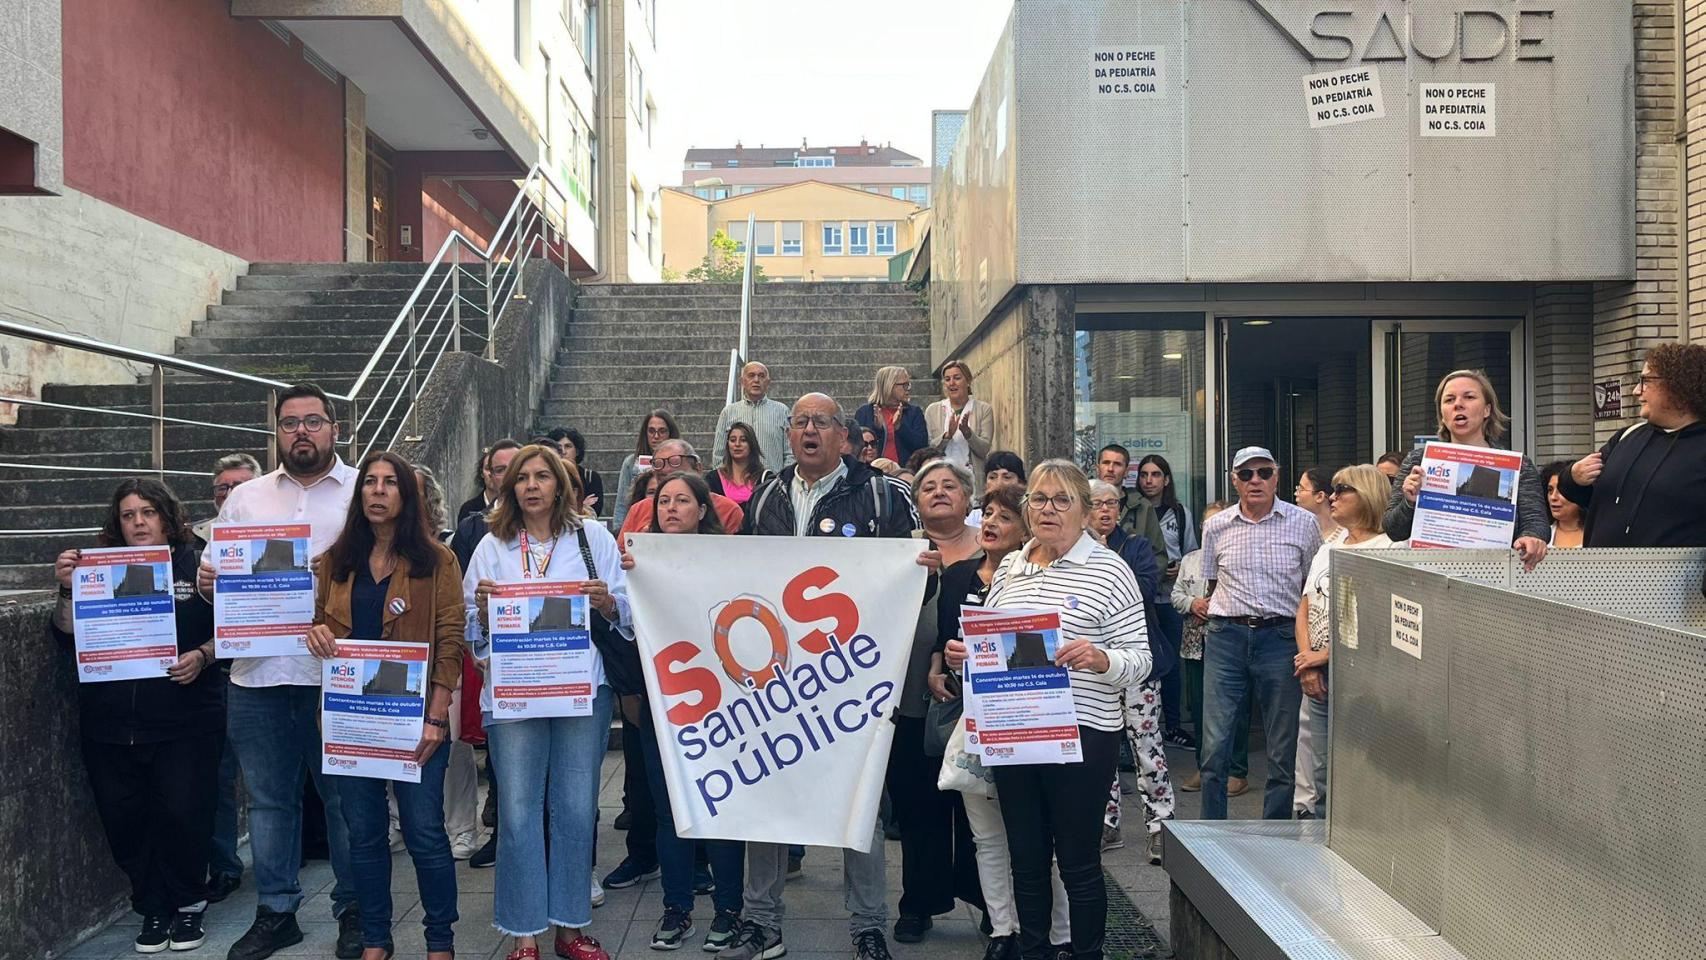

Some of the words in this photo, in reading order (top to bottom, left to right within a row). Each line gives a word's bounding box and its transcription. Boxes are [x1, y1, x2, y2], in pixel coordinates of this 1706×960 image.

[1095, 52, 1114, 61] NON
[1117, 52, 1123, 61] O
[1126, 52, 1155, 60] PECHE
[1095, 69, 1107, 77] DA
[1110, 65, 1156, 77] PEDIATRÍA
[1310, 79, 1329, 89] NON
[1331, 77, 1338, 86] O
[1340, 72, 1370, 84] PECHE
[1099, 85, 1111, 93] NO
[1115, 84, 1131, 93] C.S.
[1134, 83, 1155, 92] COIA
[1426, 89, 1444, 98] NON
[1448, 89, 1454, 98] O
[1457, 89, 1486, 98] PECHE
[1312, 96, 1324, 105] DA
[1326, 87, 1372, 103] PEDIATRÍA
[1318, 111, 1330, 120] NO
[1333, 108, 1350, 118] C.S.
[1352, 104, 1374, 115] COIA
[1426, 105, 1437, 114] DA
[1440, 103, 1486, 114] PEDIATRÍA
[1429, 121, 1442, 129] NO
[1444, 121, 1461, 130] C.S.
[1464, 121, 1485, 129] COIA
[1607, 391, 1620, 402] 24h
[1123, 438, 1163, 448] delito
[653, 566, 860, 726] SOS
[677, 634, 881, 760] sanidade
[695, 681, 894, 817] pública
